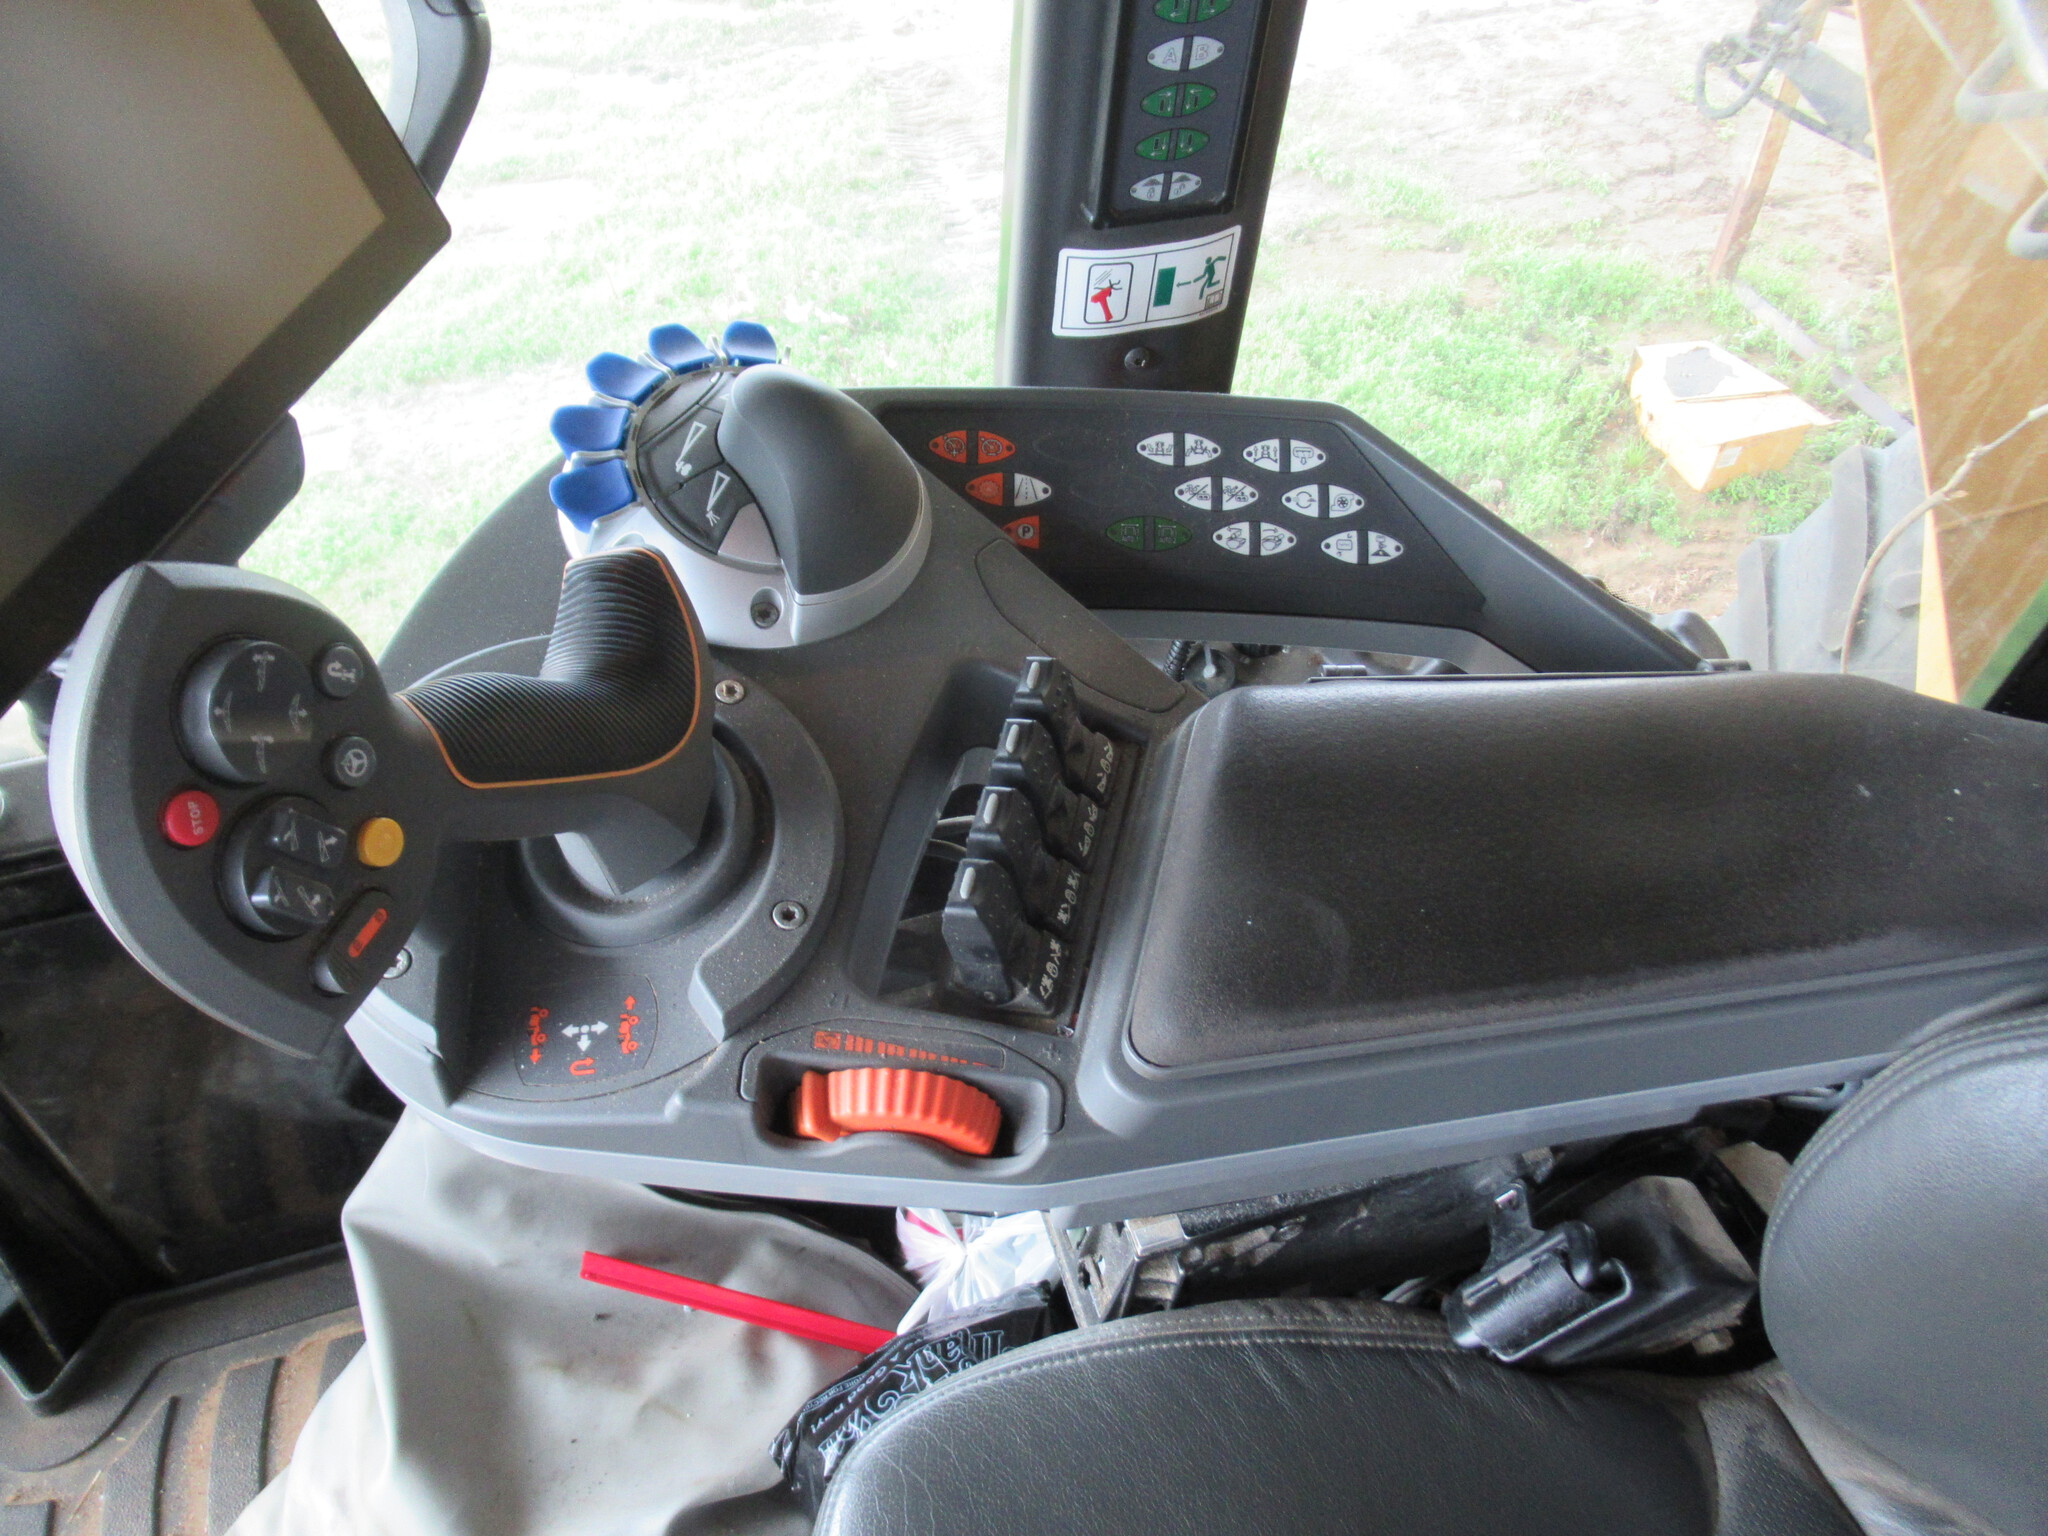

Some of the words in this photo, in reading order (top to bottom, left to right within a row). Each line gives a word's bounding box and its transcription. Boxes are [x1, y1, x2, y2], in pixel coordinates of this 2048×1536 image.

[1162, 46, 1177, 65] A
[1194, 43, 1211, 61] B
[187, 801, 205, 836] STOP
